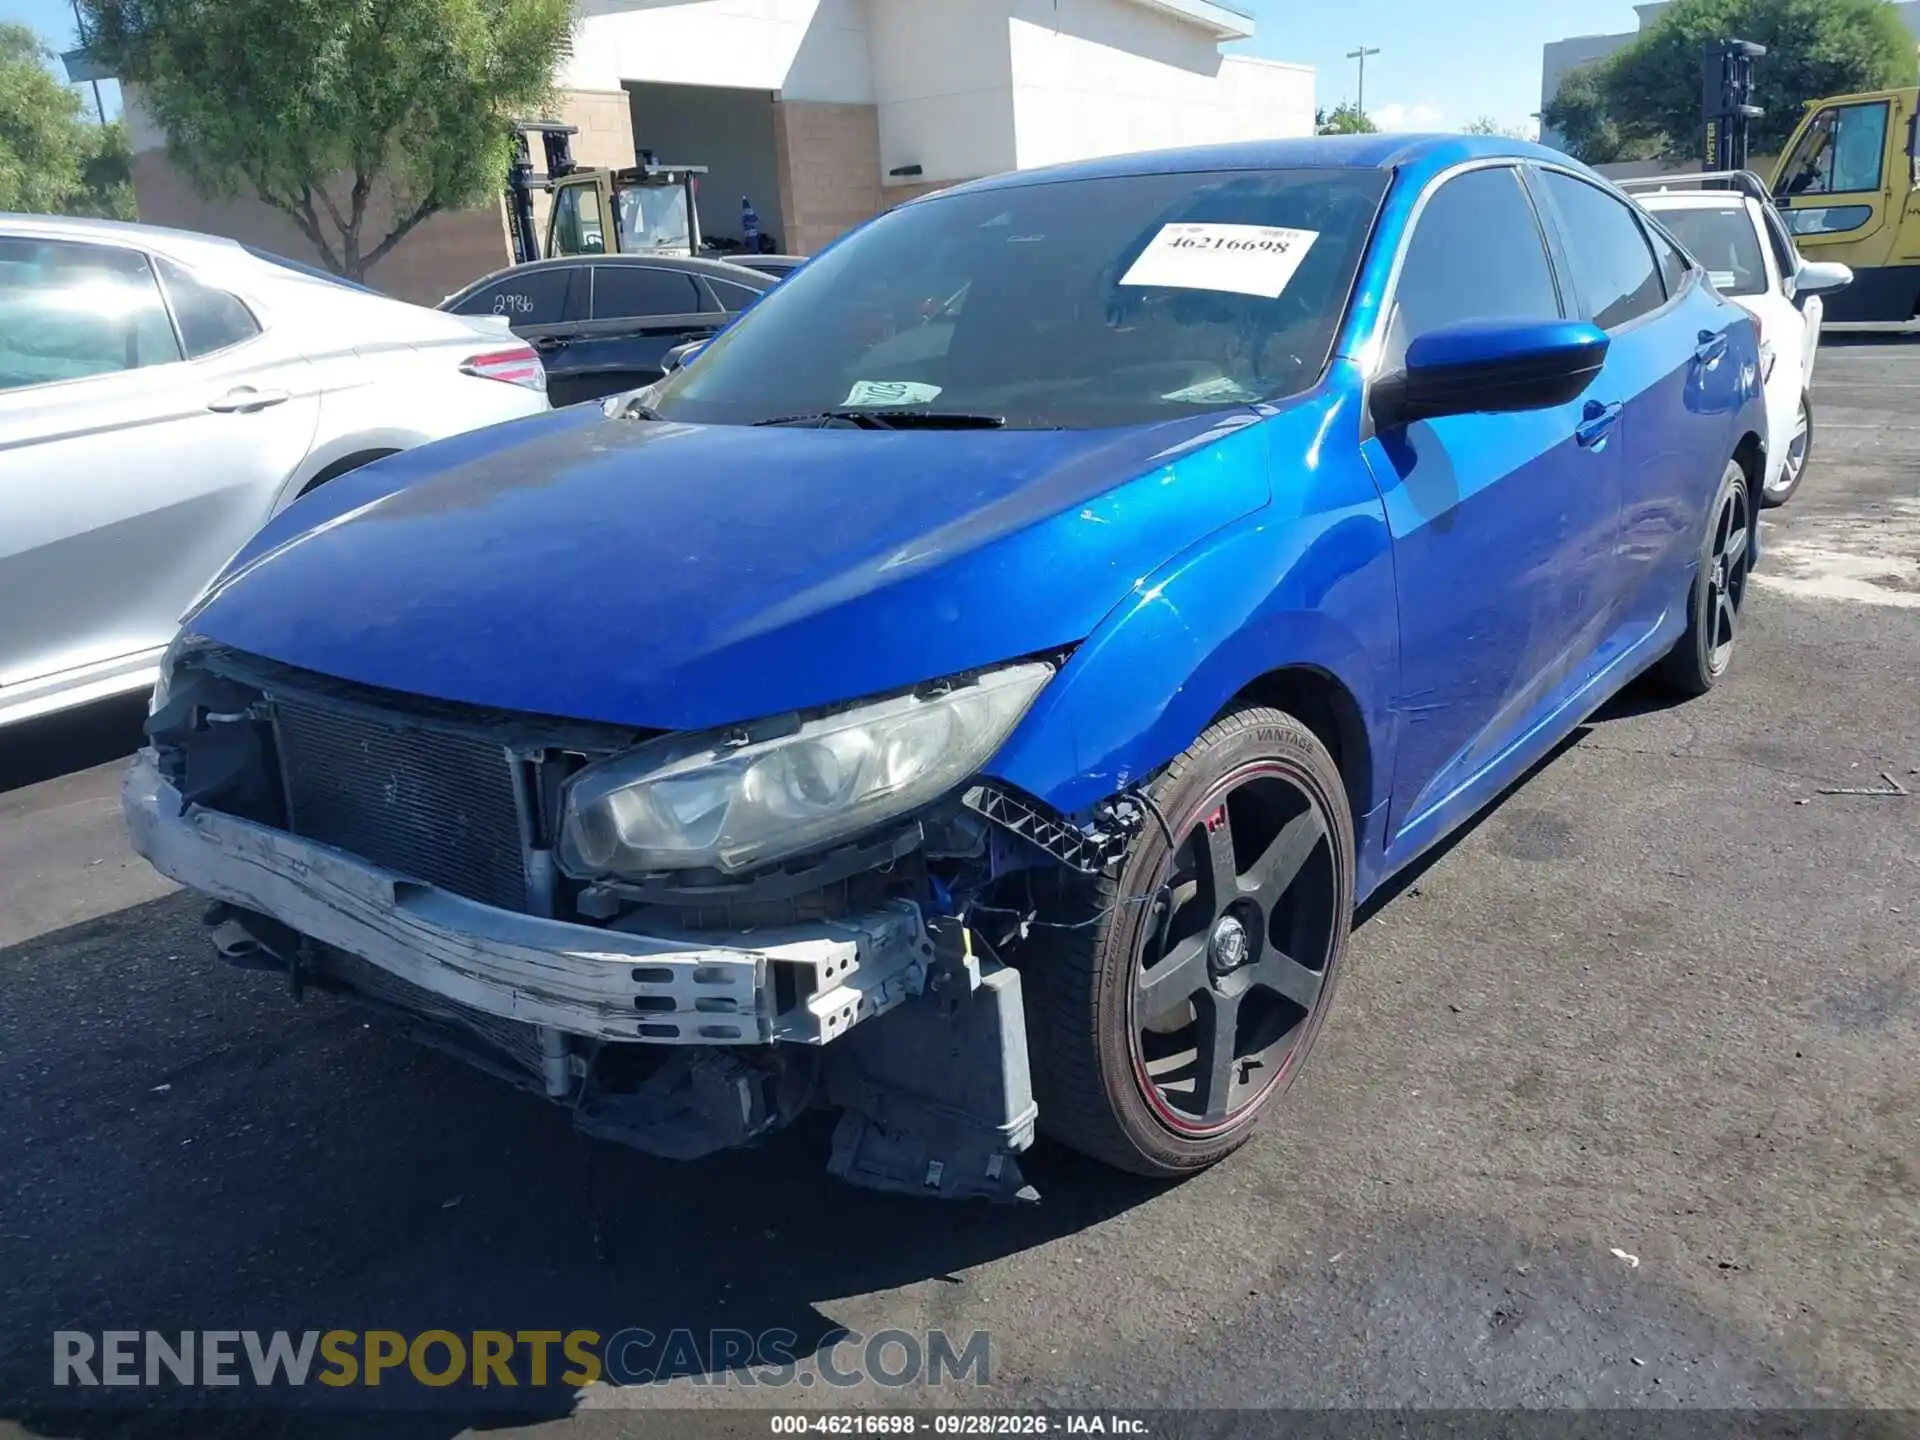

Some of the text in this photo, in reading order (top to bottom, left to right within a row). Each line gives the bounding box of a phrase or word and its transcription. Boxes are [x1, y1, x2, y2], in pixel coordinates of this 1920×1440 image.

[1706, 122, 1716, 165] HYSTER
[1167, 235, 1290, 254] 46216698
[1256, 728, 1315, 755] VANTAGE
